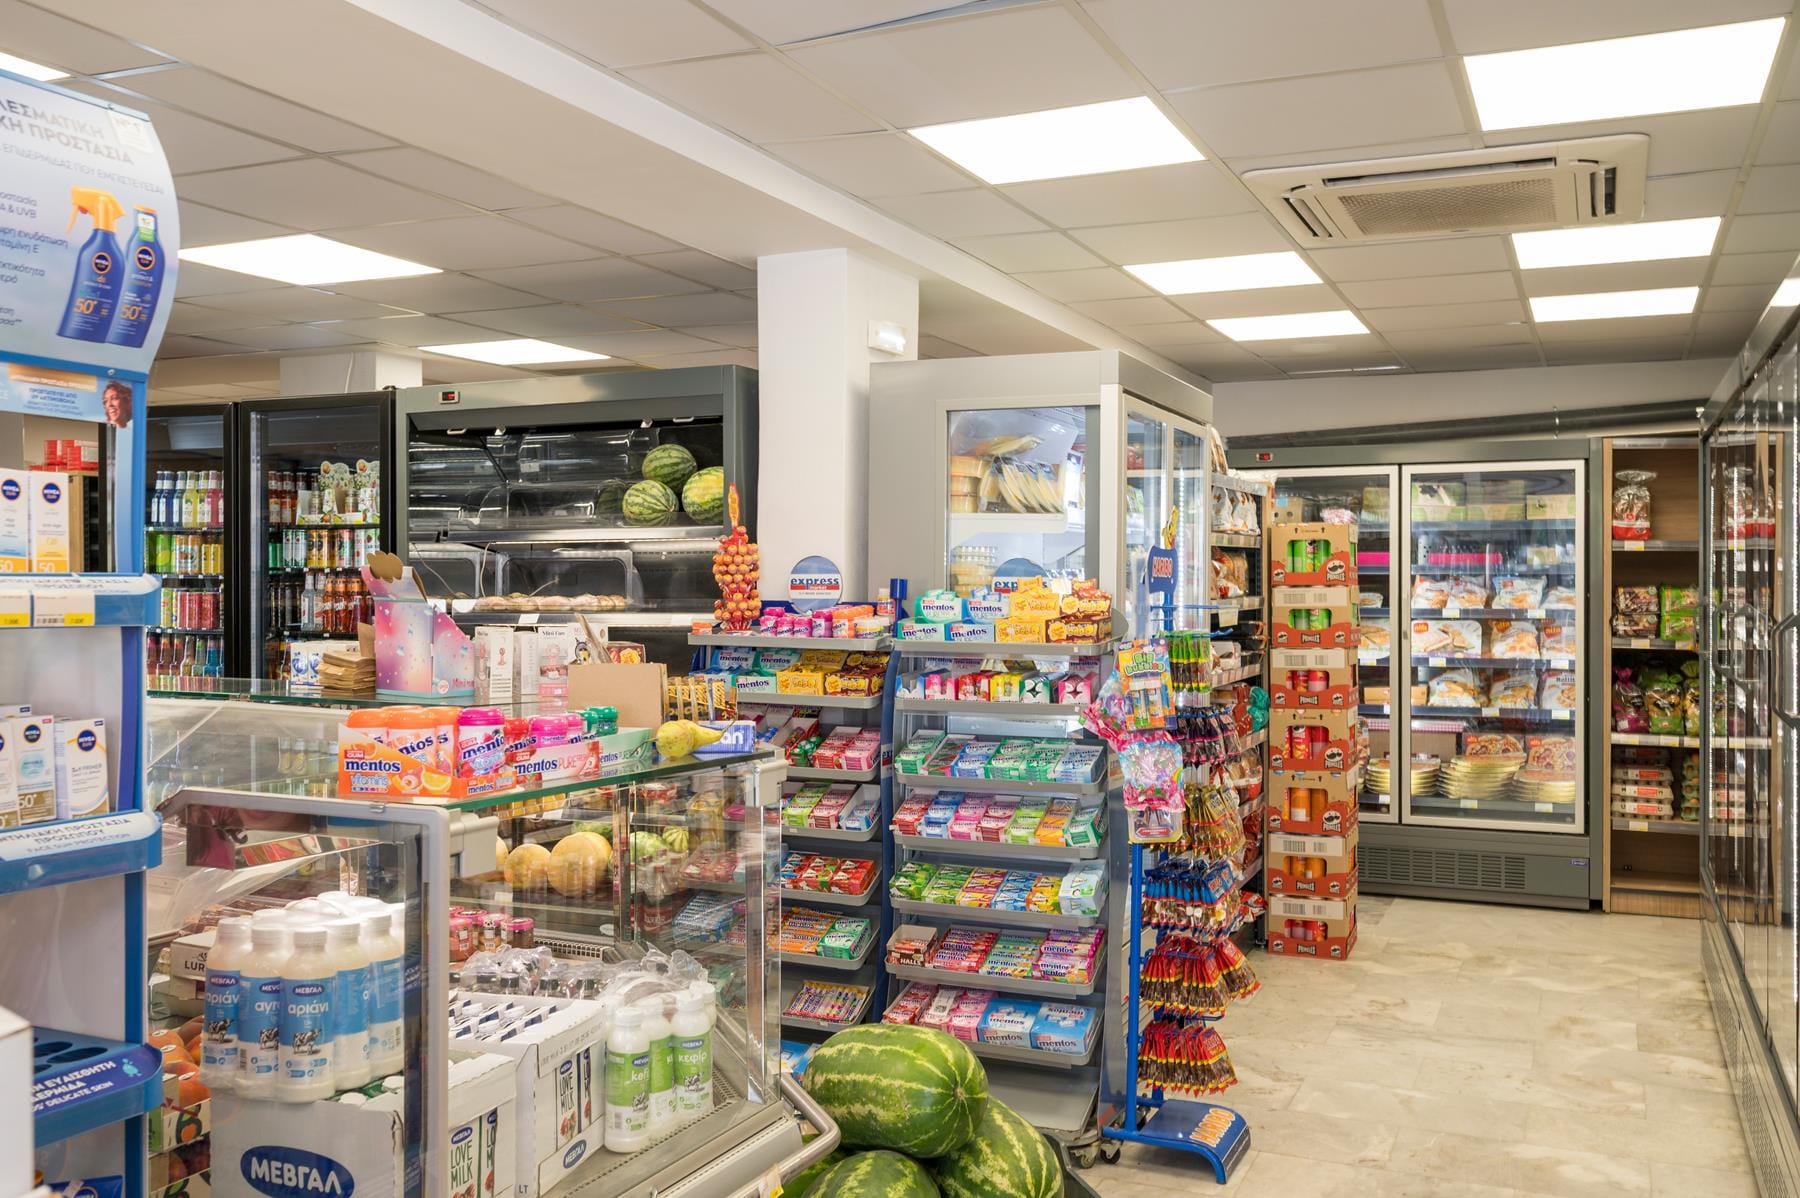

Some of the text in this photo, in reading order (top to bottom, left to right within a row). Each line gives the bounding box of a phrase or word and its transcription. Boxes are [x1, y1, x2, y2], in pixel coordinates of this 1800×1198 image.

[29, 122, 134, 166] ΠΡΟΣΤΑΣΙΑ
[1152, 556, 1173, 578] HARIBO
[790, 577, 840, 590] express
[903, 627, 937, 637] metos
[737, 679, 770, 689] mentos
[345, 759, 401, 772] mentos
[514, 757, 577, 775] mentos PURE
[468, 783, 494, 794] mentos
[64, 818, 132, 833] ΠΡΟΣΤΑΣΙΑ
[34, 828, 105, 845] ΠΡΟΣΩΠΟΥ
[943, 942, 972, 951] mentos
[1043, 944, 1075, 954] mentos
[900, 958, 922, 966] HALLS
[211, 976, 236, 985] ΜΕΒΓΑΛ
[294, 986, 323, 994] ΜΕΒΓΑΛ
[254, 1000, 280, 1015] ayr
[287, 1000, 329, 1017] αριάνι
[990, 1018, 1025, 1026] mentos
[986, 1032, 1023, 1042] mentos
[1039, 1040, 1077, 1048] mentos
[678, 1050, 708, 1065] κεφίρ
[44, 1060, 117, 1088] ΕΥΑΙΣΘΗΤΗ
[560, 1071, 573, 1097] LOVE
[45, 1080, 115, 1108] DELICATE SKIN
[560, 1090, 575, 1114] MILK
[1189, 1108, 1236, 1148] HARIBO
[450, 1140, 473, 1169] LOVE
[565, 1143, 585, 1165] ΜΕΒΓΑΛ
[250, 1156, 342, 1195] ΜΕΒΓΑΛ
[450, 1161, 474, 1190] MILK
